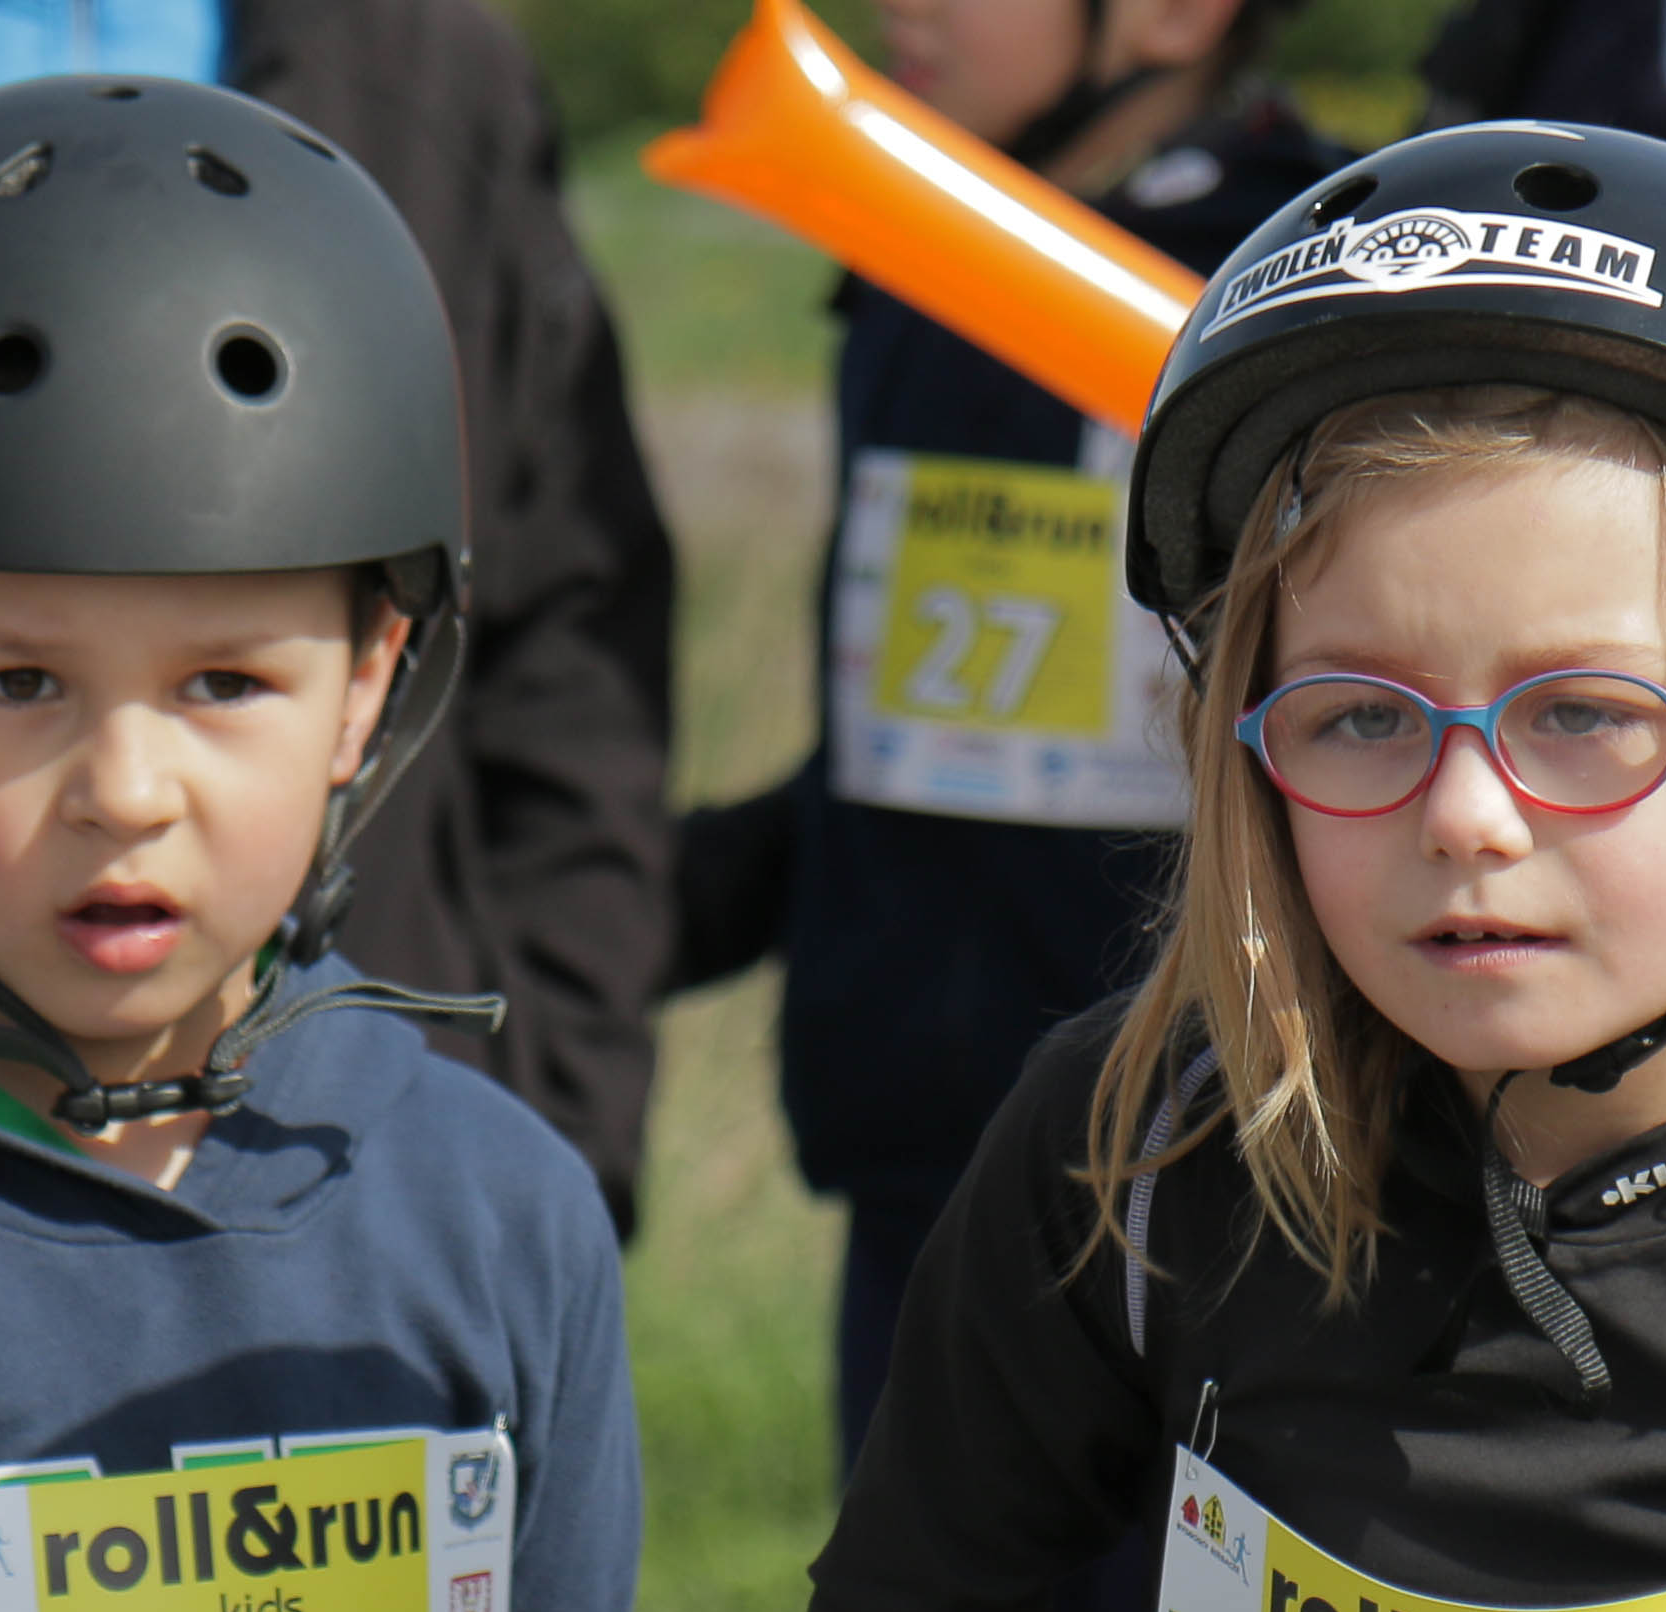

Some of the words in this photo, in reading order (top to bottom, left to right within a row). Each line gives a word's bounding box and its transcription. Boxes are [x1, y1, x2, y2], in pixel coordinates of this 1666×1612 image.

[1479, 222, 1641, 283] TEAM
[899, 580, 1067, 720] 27
[42, 1484, 421, 1597] roll&run
